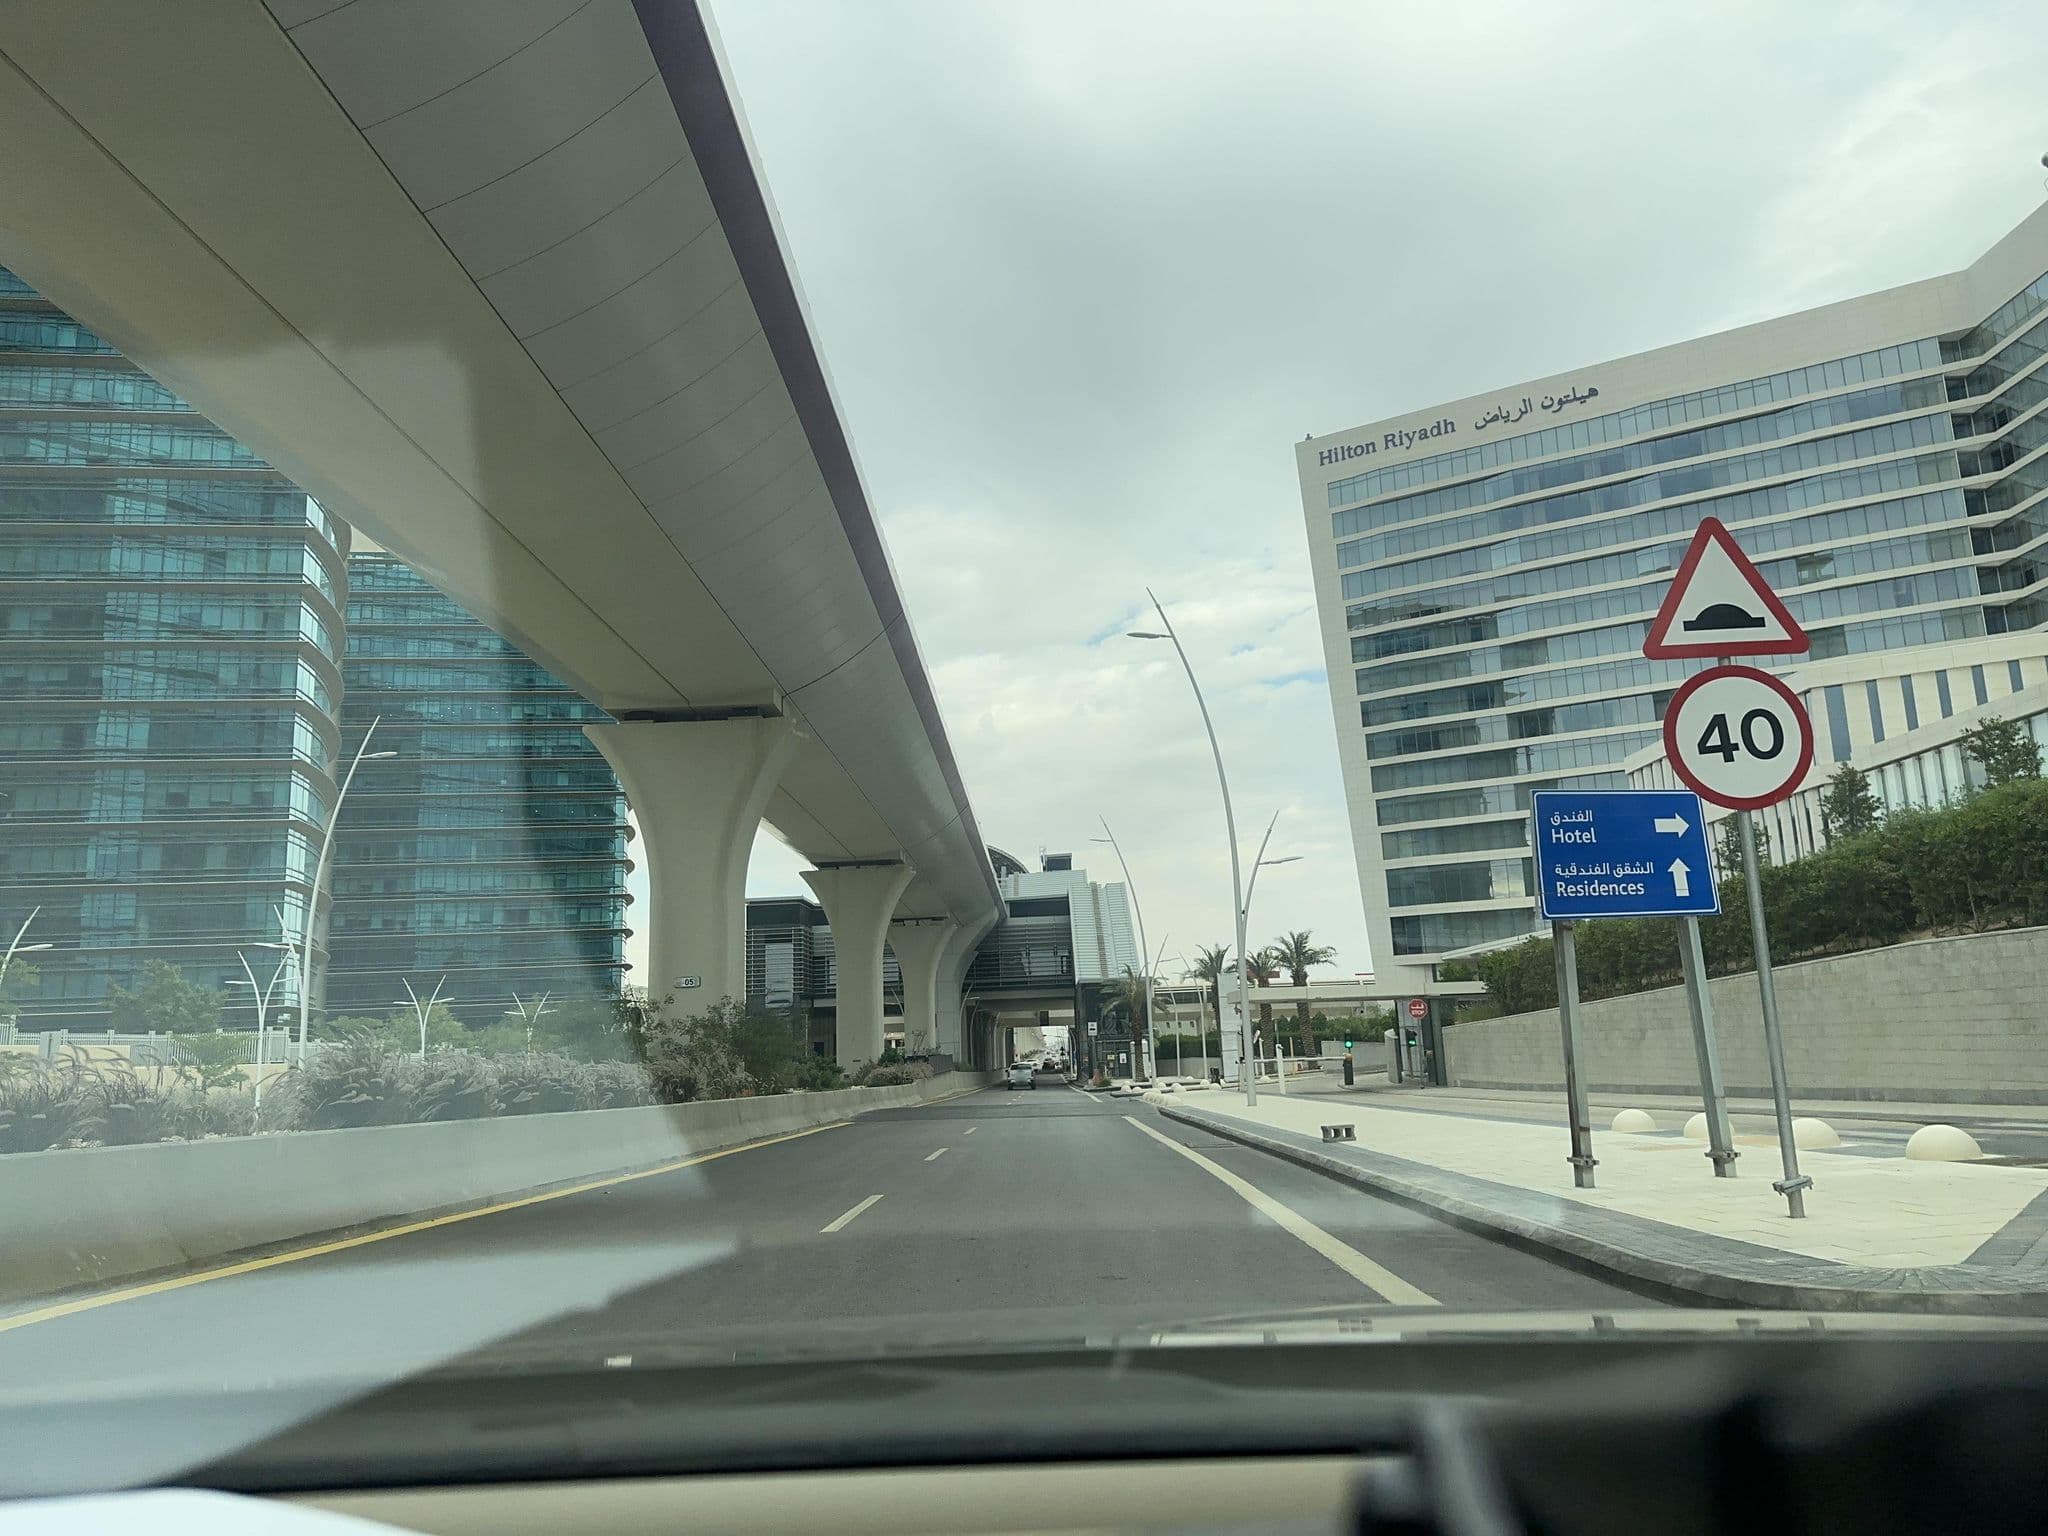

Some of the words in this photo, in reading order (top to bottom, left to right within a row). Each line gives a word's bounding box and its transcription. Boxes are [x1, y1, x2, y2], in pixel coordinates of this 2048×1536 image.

[1541, 385, 1599, 413] هيلتون
[1474, 396, 1533, 430] الرياض
[1318, 440, 1378, 467] Hilton
[1383, 417, 1457, 451] Riyadh
[1697, 708, 1784, 763] 40
[1550, 810, 1593, 826] الفندق
[1551, 827, 1597, 844] Hotel
[1554, 862, 1610, 878] الفندقية
[1612, 862, 1655, 878] الشقق
[1556, 880, 1645, 897] Residences
